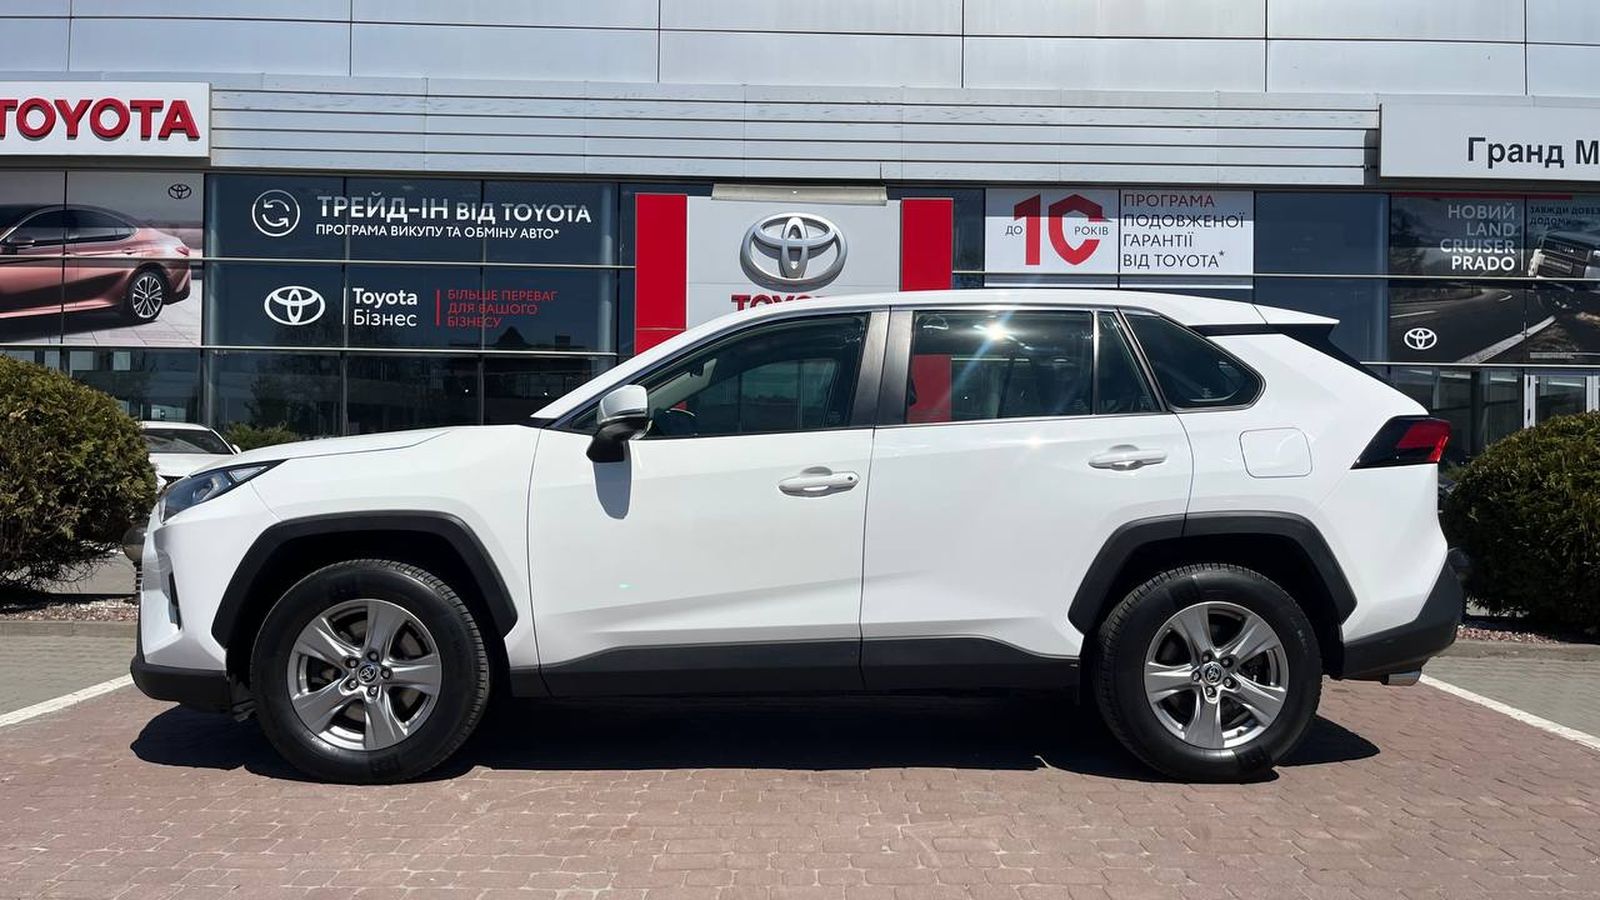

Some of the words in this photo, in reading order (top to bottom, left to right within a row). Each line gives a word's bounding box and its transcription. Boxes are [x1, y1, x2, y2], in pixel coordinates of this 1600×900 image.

[0, 97, 200, 141] TOYOTA
[1468, 137, 1565, 169] Гранд
[317, 191, 449, 223] ТРЕЙД-ІН
[456, 203, 496, 225] ВІД
[501, 203, 592, 223] TOYOTA
[1123, 194, 1215, 208] ПРОГРАМА
[1447, 202, 1516, 220] НОВИЙ
[1123, 211, 1245, 229] ПОДОВЖЕНОЇ
[315, 224, 388, 236] ПРОГРАМА
[391, 225, 443, 237] ВИКУПУ
[445, 226, 462, 238] ТА
[464, 226, 518, 239] ОБМІНУ
[1005, 225, 1023, 236] ДО
[1074, 226, 1109, 236] РОКІВ
[1466, 222, 1516, 237] LAND
[1123, 231, 1194, 248] ГАРАНТІЇ
[1440, 238, 1516, 254] CRUISER
[1123, 254, 1150, 270] ВІД
[1451, 255, 1516, 271] PRADO
[352, 287, 418, 309] Toyota
[447, 289, 498, 300] БІЛЬШЕ
[502, 290, 559, 301] ПЕРЕВАГ
[448, 303, 475, 314] ДЛЯ
[478, 304, 537, 315] ВАШОГО
[353, 309, 417, 327] Бізнес
[447, 317, 502, 328] БІЗНЕСУ
